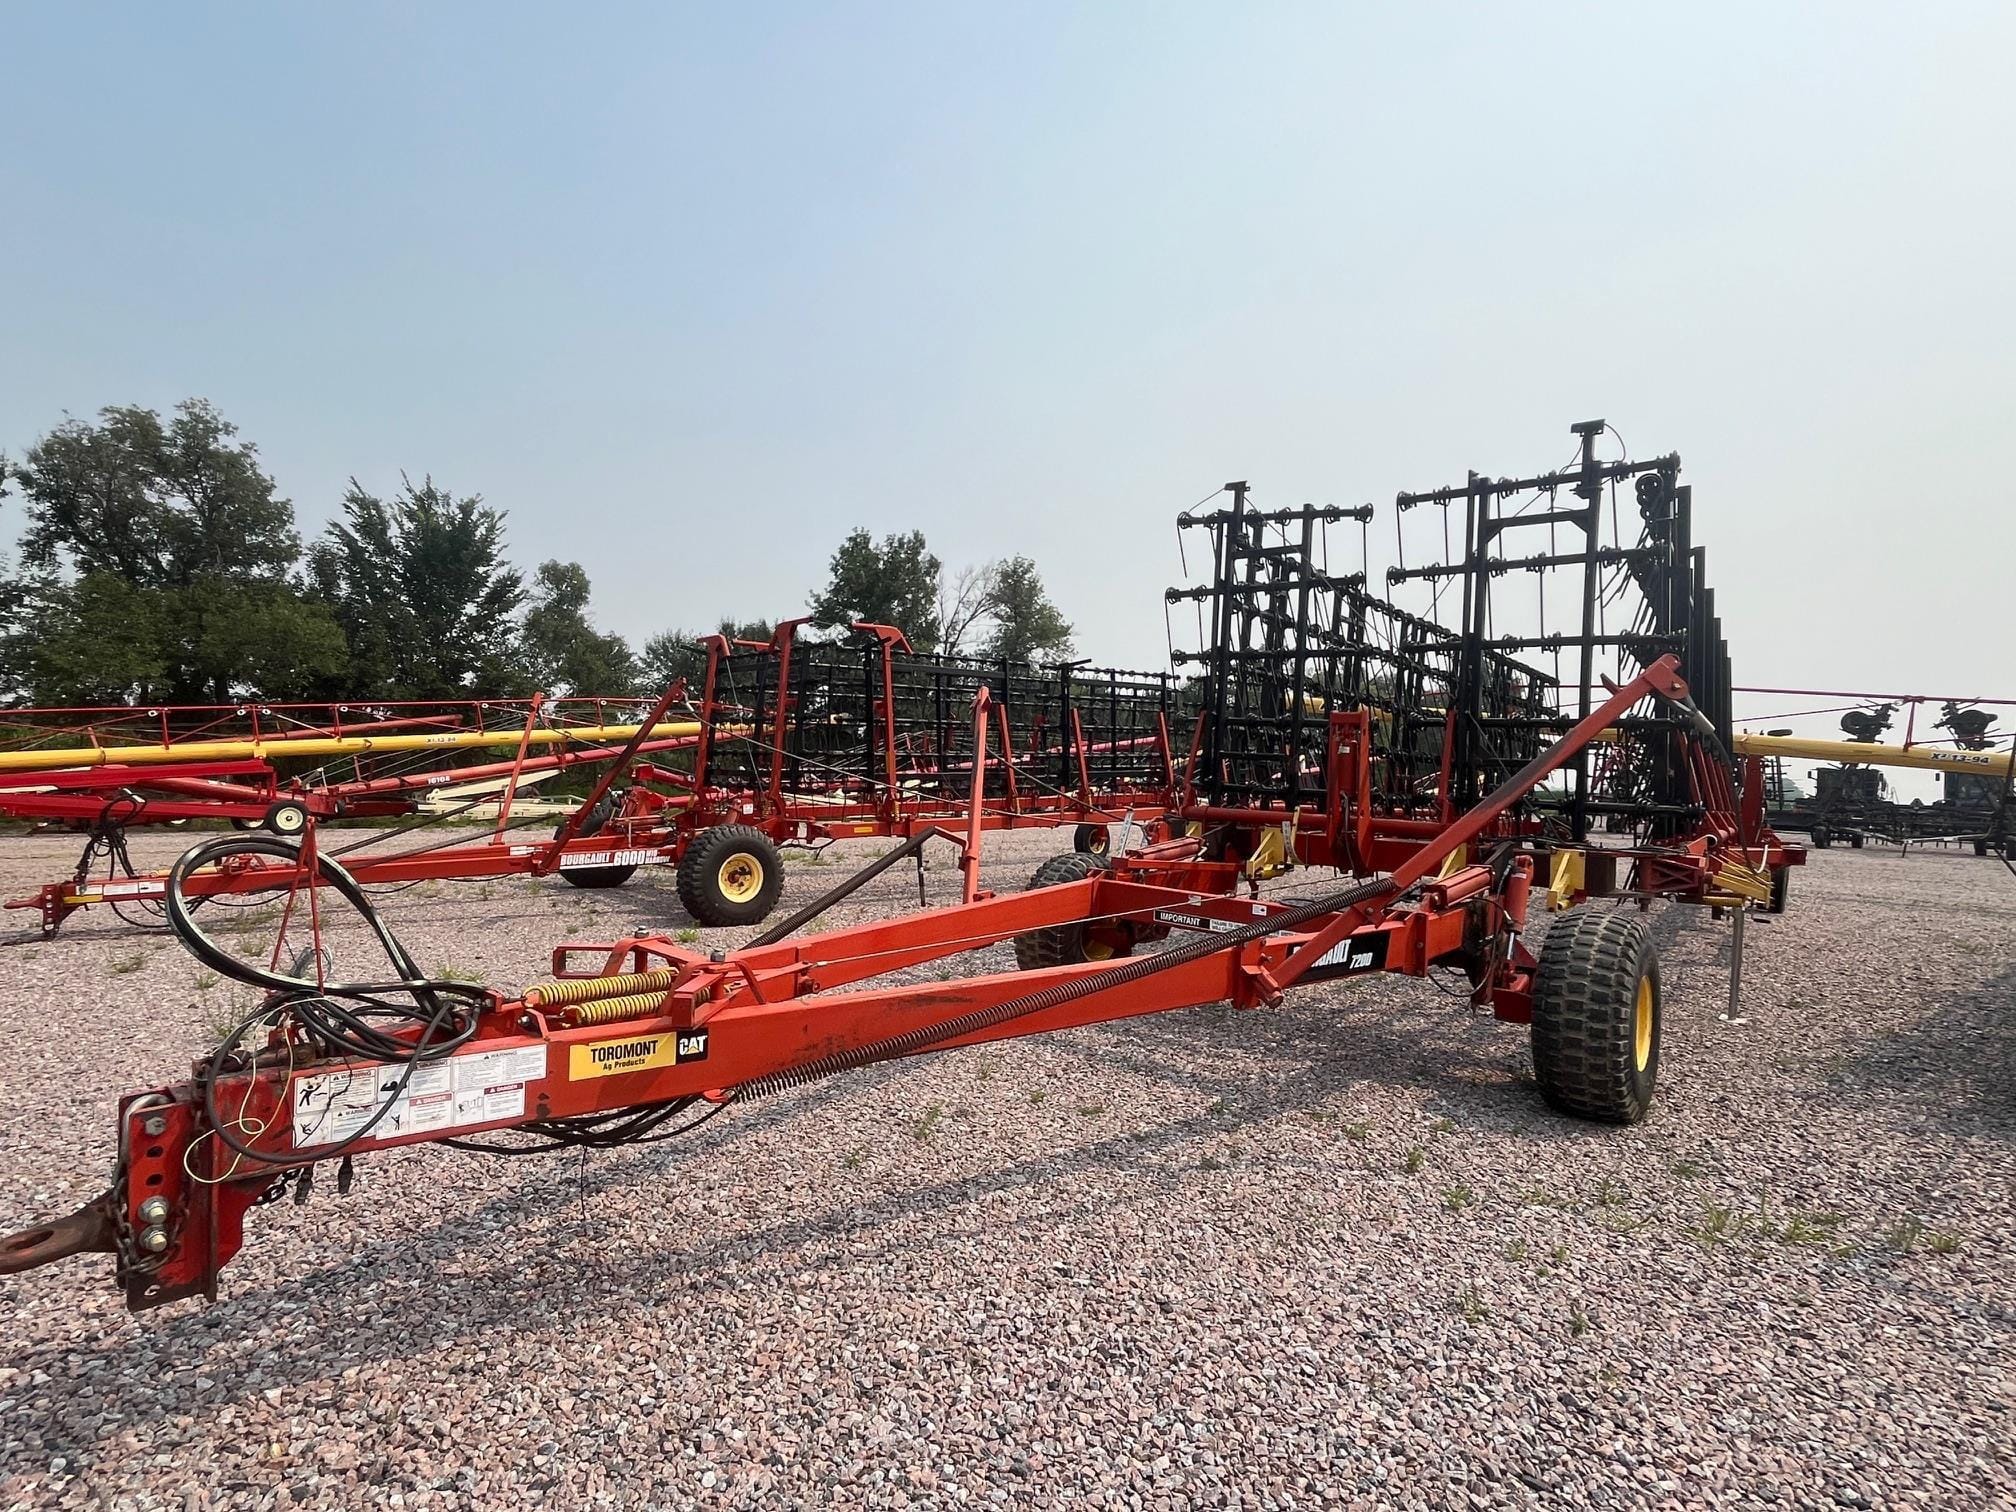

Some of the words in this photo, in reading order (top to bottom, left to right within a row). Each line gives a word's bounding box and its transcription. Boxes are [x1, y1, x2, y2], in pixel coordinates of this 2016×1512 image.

[1951, 754, 1989, 763] 13-94
[560, 853, 611, 866] BOURGAULT
[614, 850, 646, 866] 6000
[1160, 911, 1201, 926] IMPORTANT
[1349, 952, 1374, 969] 7200
[591, 1040, 658, 1063] TOROMONT
[679, 1035, 708, 1056] CAT
[603, 1063, 612, 1071] Ag
[614, 1058, 645, 1069] Products
